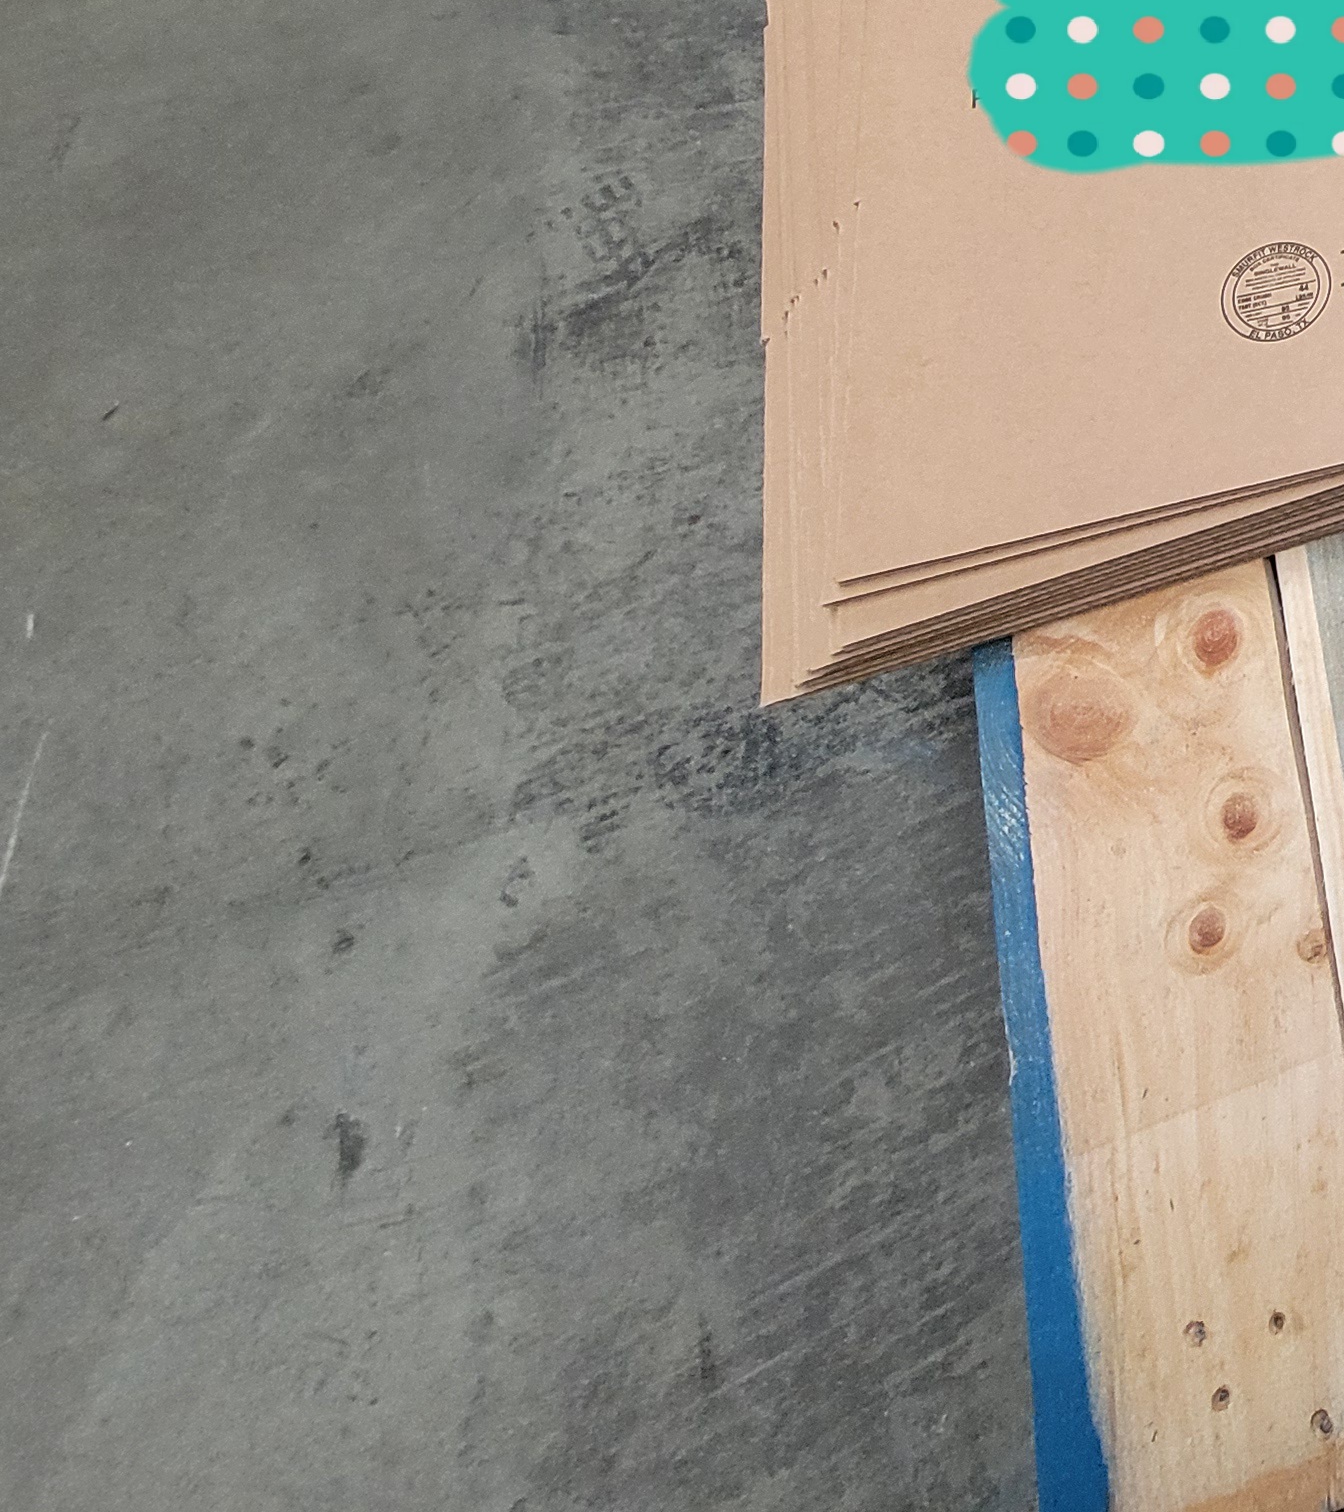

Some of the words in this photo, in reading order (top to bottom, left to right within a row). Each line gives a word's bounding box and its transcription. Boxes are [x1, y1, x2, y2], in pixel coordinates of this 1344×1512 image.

[1232, 248, 1266, 278] SMURFIT
[1269, 244, 1318, 263] WESTROCK
[1249, 329, 1261, 339] EL
[1296, 318, 1310, 329] TX
